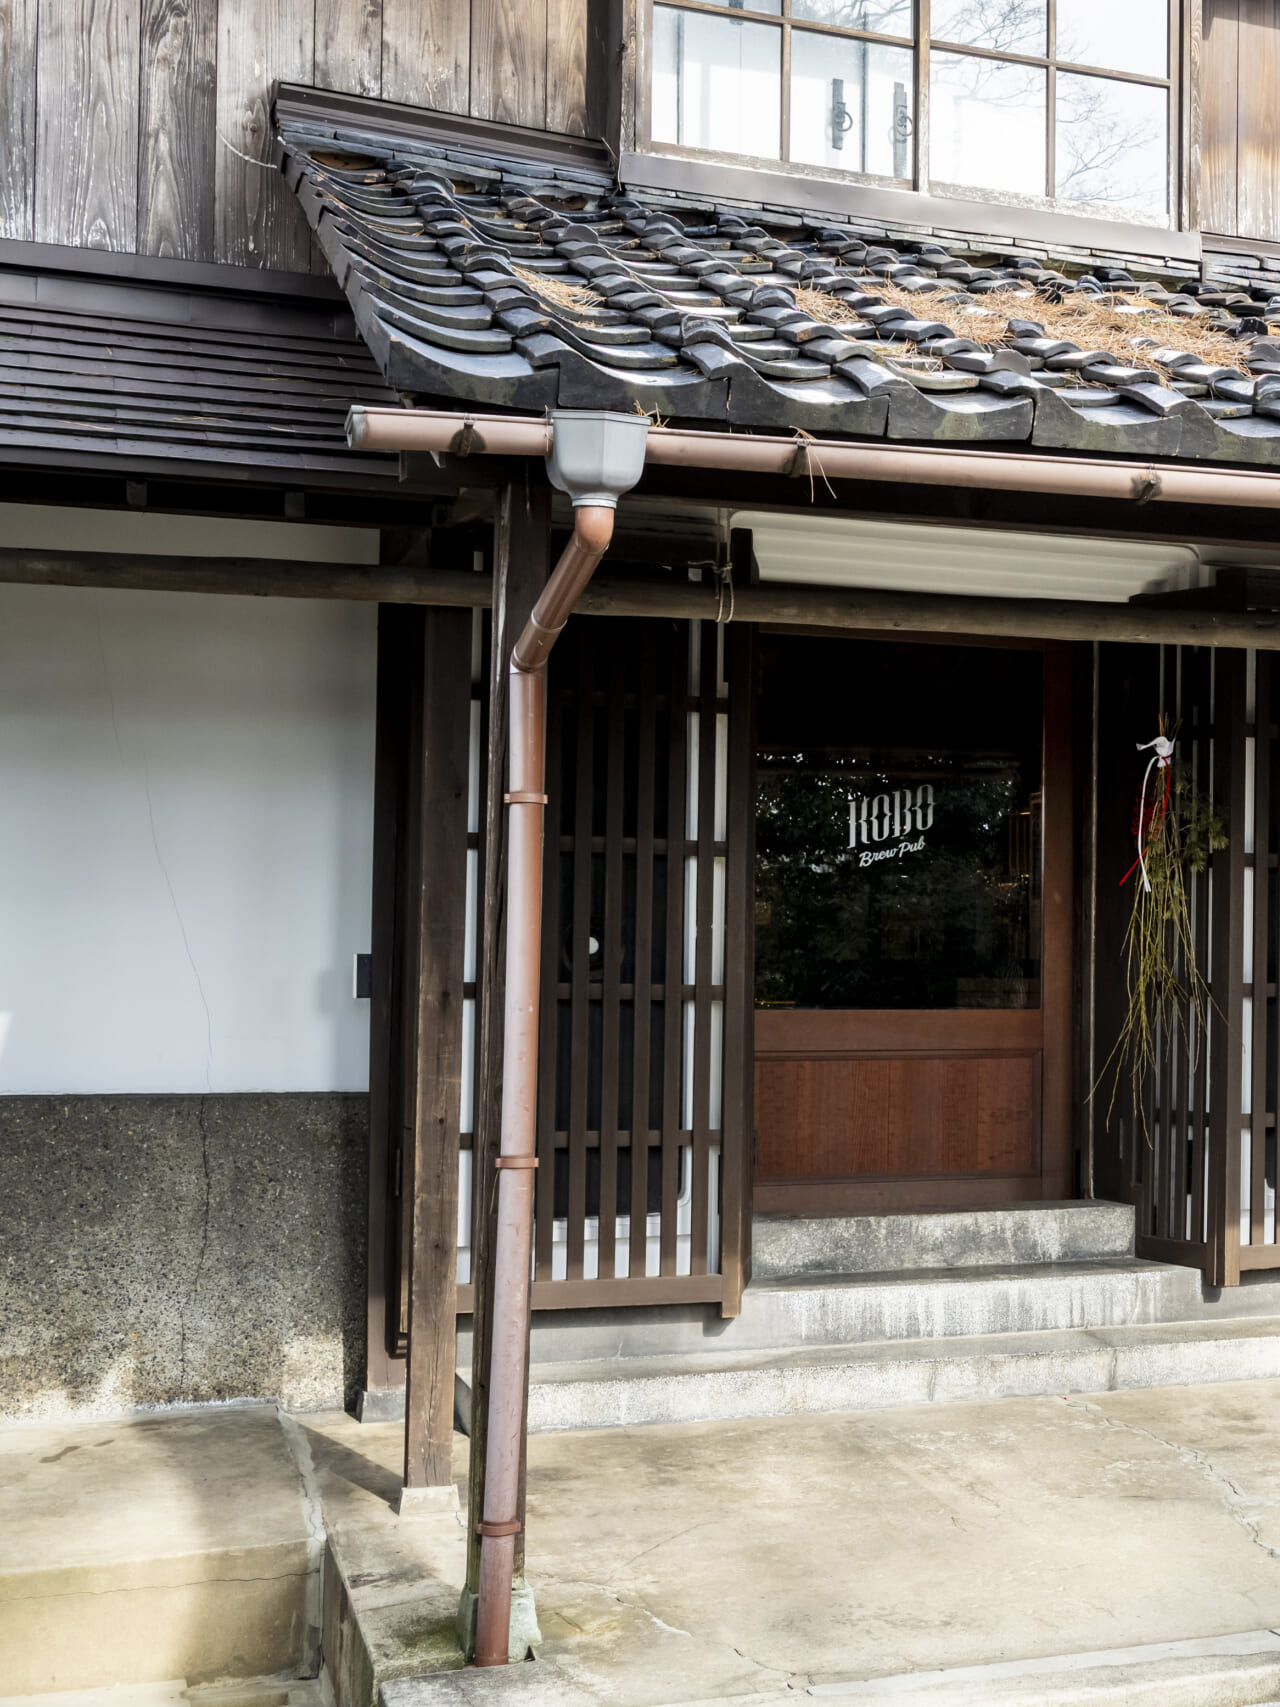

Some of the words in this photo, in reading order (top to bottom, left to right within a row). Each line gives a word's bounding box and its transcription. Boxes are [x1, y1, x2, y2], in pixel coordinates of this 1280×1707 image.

[847, 784, 936, 849] KOBO
[859, 848, 899, 867] Brew
[898, 835, 926, 858] Pub
